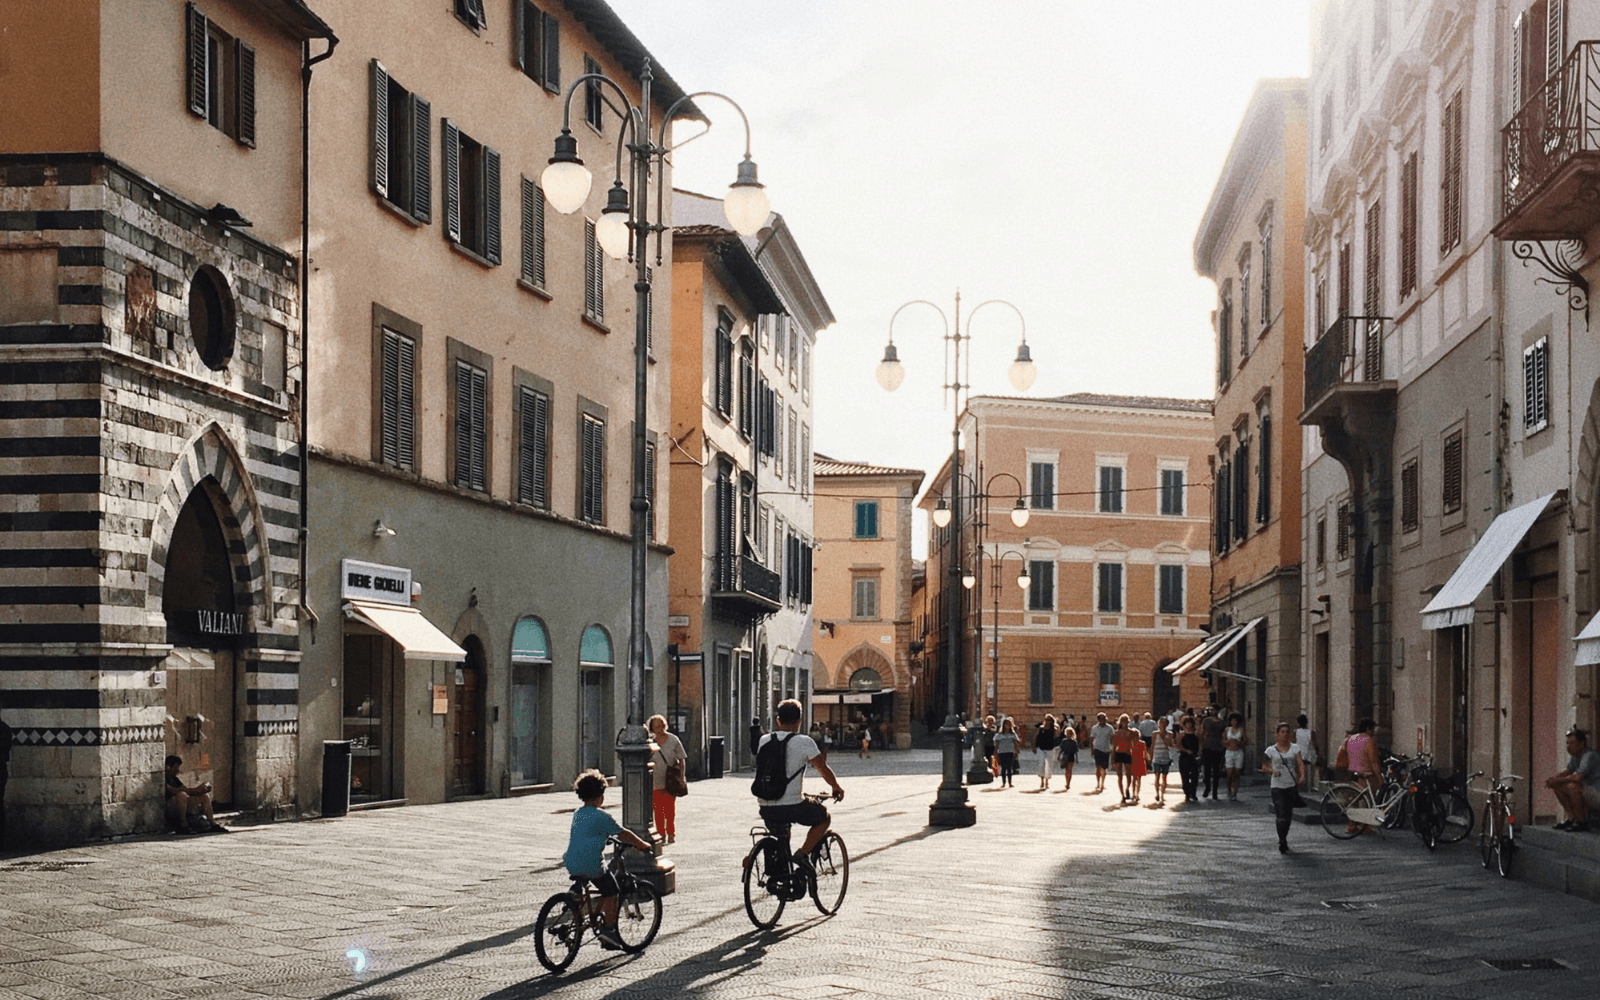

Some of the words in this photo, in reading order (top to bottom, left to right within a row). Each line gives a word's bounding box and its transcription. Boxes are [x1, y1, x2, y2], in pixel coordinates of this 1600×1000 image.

[348, 572, 372, 589] IRENE
[374, 576, 404, 593] GIOIELLI
[198, 609, 243, 634] VALIANI
